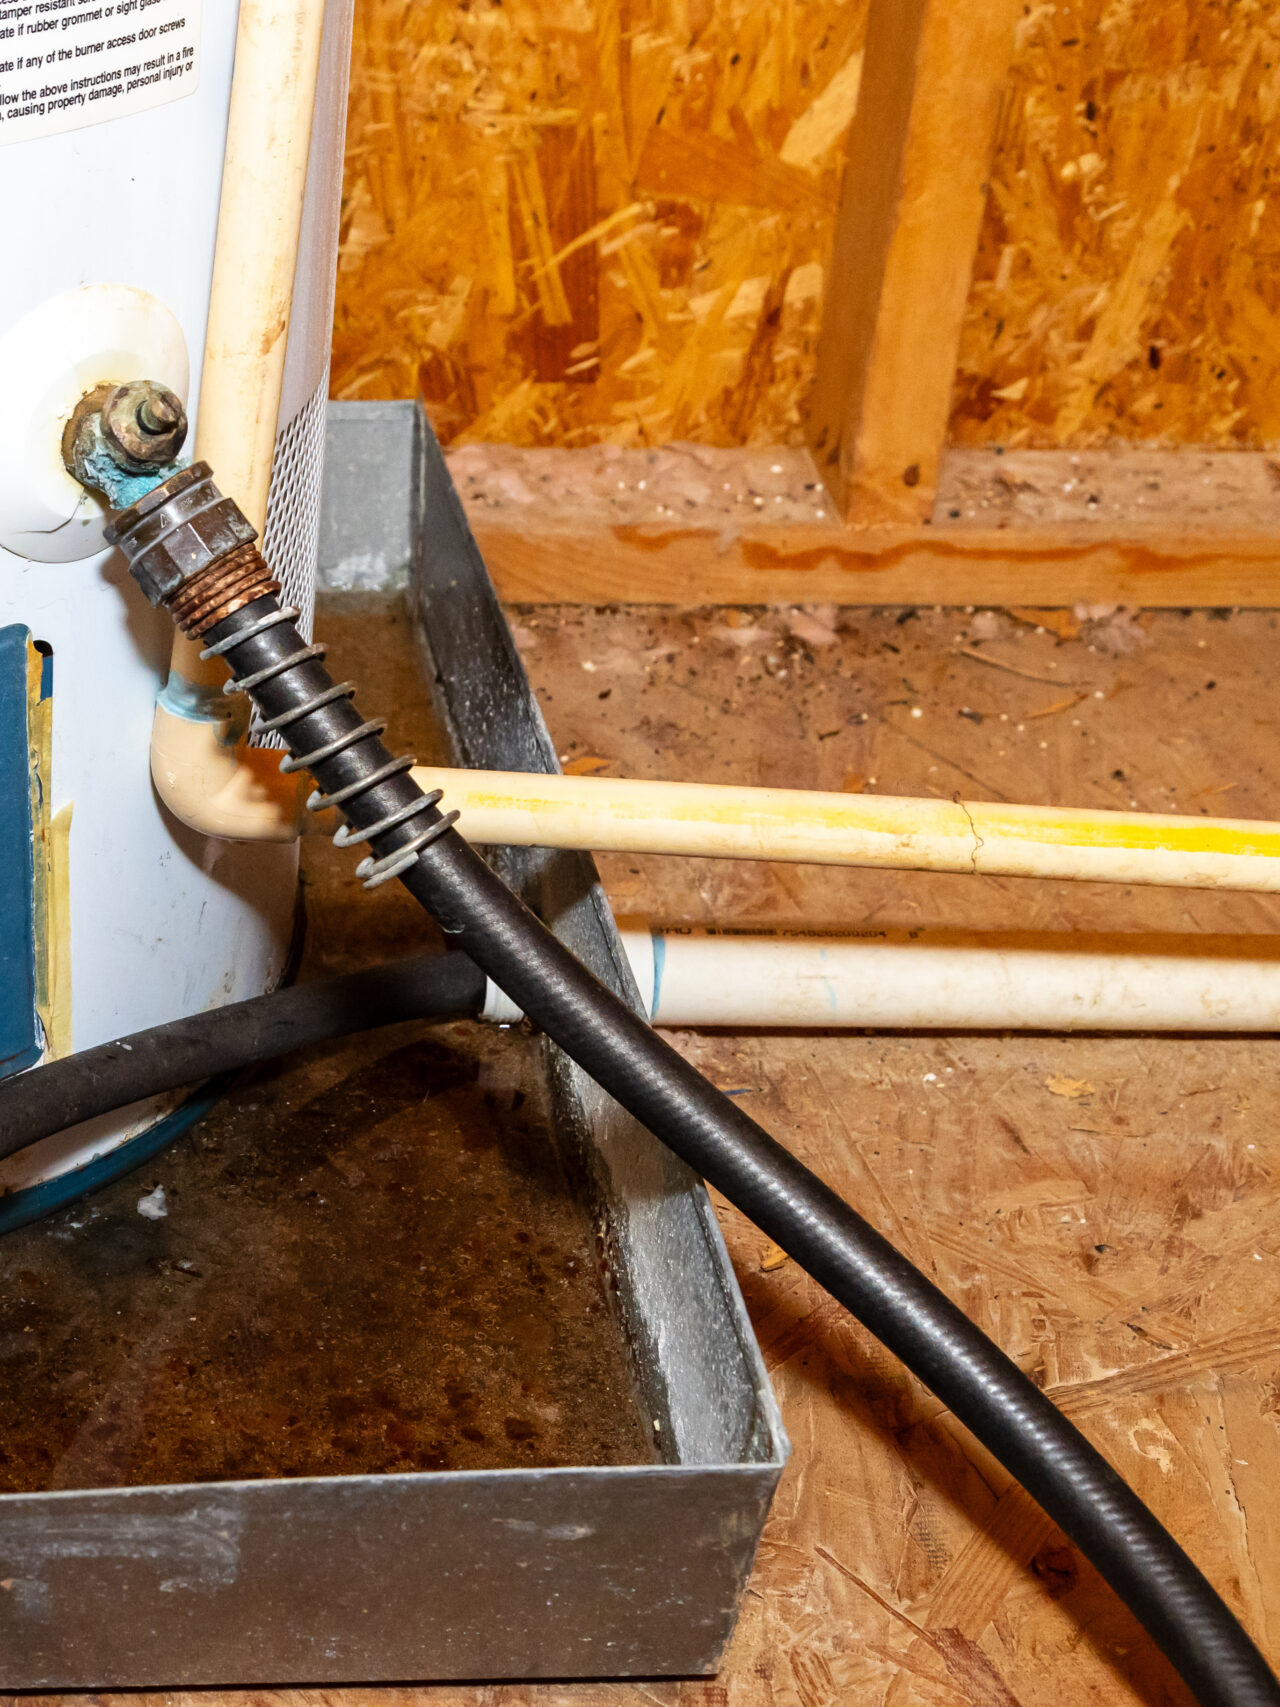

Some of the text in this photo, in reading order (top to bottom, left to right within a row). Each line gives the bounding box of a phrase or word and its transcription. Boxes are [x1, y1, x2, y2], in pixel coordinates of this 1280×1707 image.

[0, 5, 32, 20] tamper
[35, 0, 75, 14] resistant
[18, 23, 24, 36] if
[27, 19, 59, 34] rubber
[62, 8, 102, 30] grommet
[105, 6, 114, 17] or
[117, 0, 137, 15] sight
[17, 56, 24, 69] if
[26, 58, 43, 69] any
[46, 50, 56, 63] of
[59, 48, 73, 60] the
[75, 42, 105, 57] burner
[107, 33, 136, 49] access
[138, 26, 157, 41] door
[159, 18, 186, 34] screws
[7, 102, 45, 119] causing
[48, 93, 86, 113] property
[88, 84, 124, 101] damage,
[127, 71, 162, 94] personal
[163, 63, 184, 80] injury
[185, 60, 194, 71] or
[22, 89, 37, 101] the
[40, 83, 68, 98] above
[70, 69, 122, 91] instructions
[124, 63, 141, 77] may
[143, 54, 165, 71] result
[167, 52, 174, 63] in
[176, 51, 180, 60] a
[182, 46, 194, 58] fire
